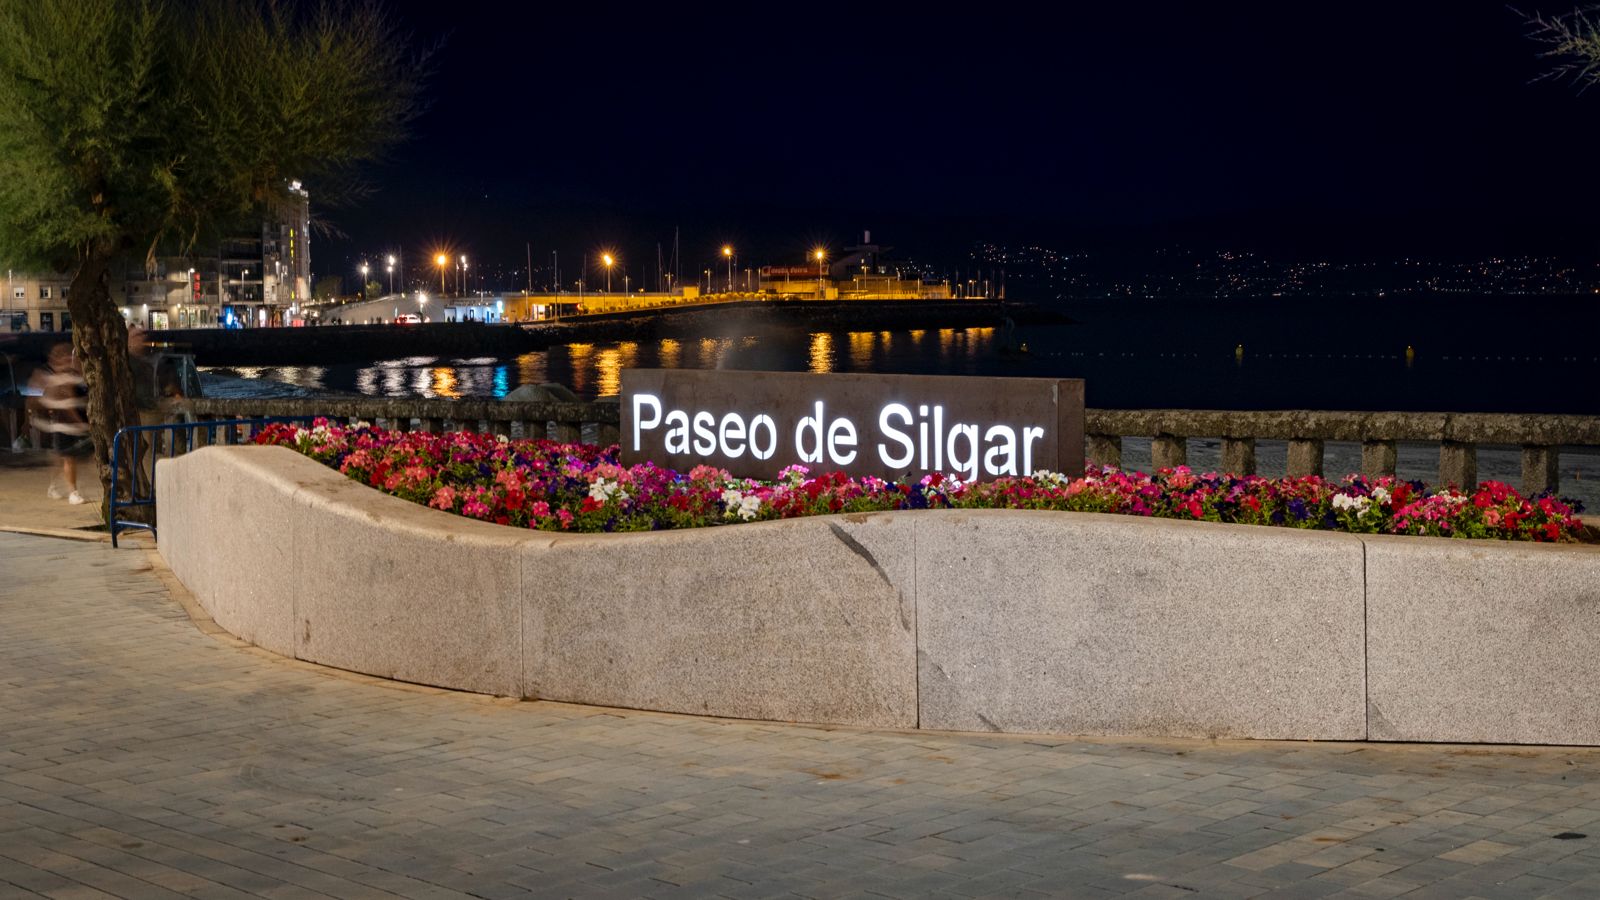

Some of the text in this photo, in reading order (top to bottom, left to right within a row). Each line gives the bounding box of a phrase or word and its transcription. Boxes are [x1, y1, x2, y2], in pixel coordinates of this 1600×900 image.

[632, 393, 1045, 484] Paseo de Silgar
